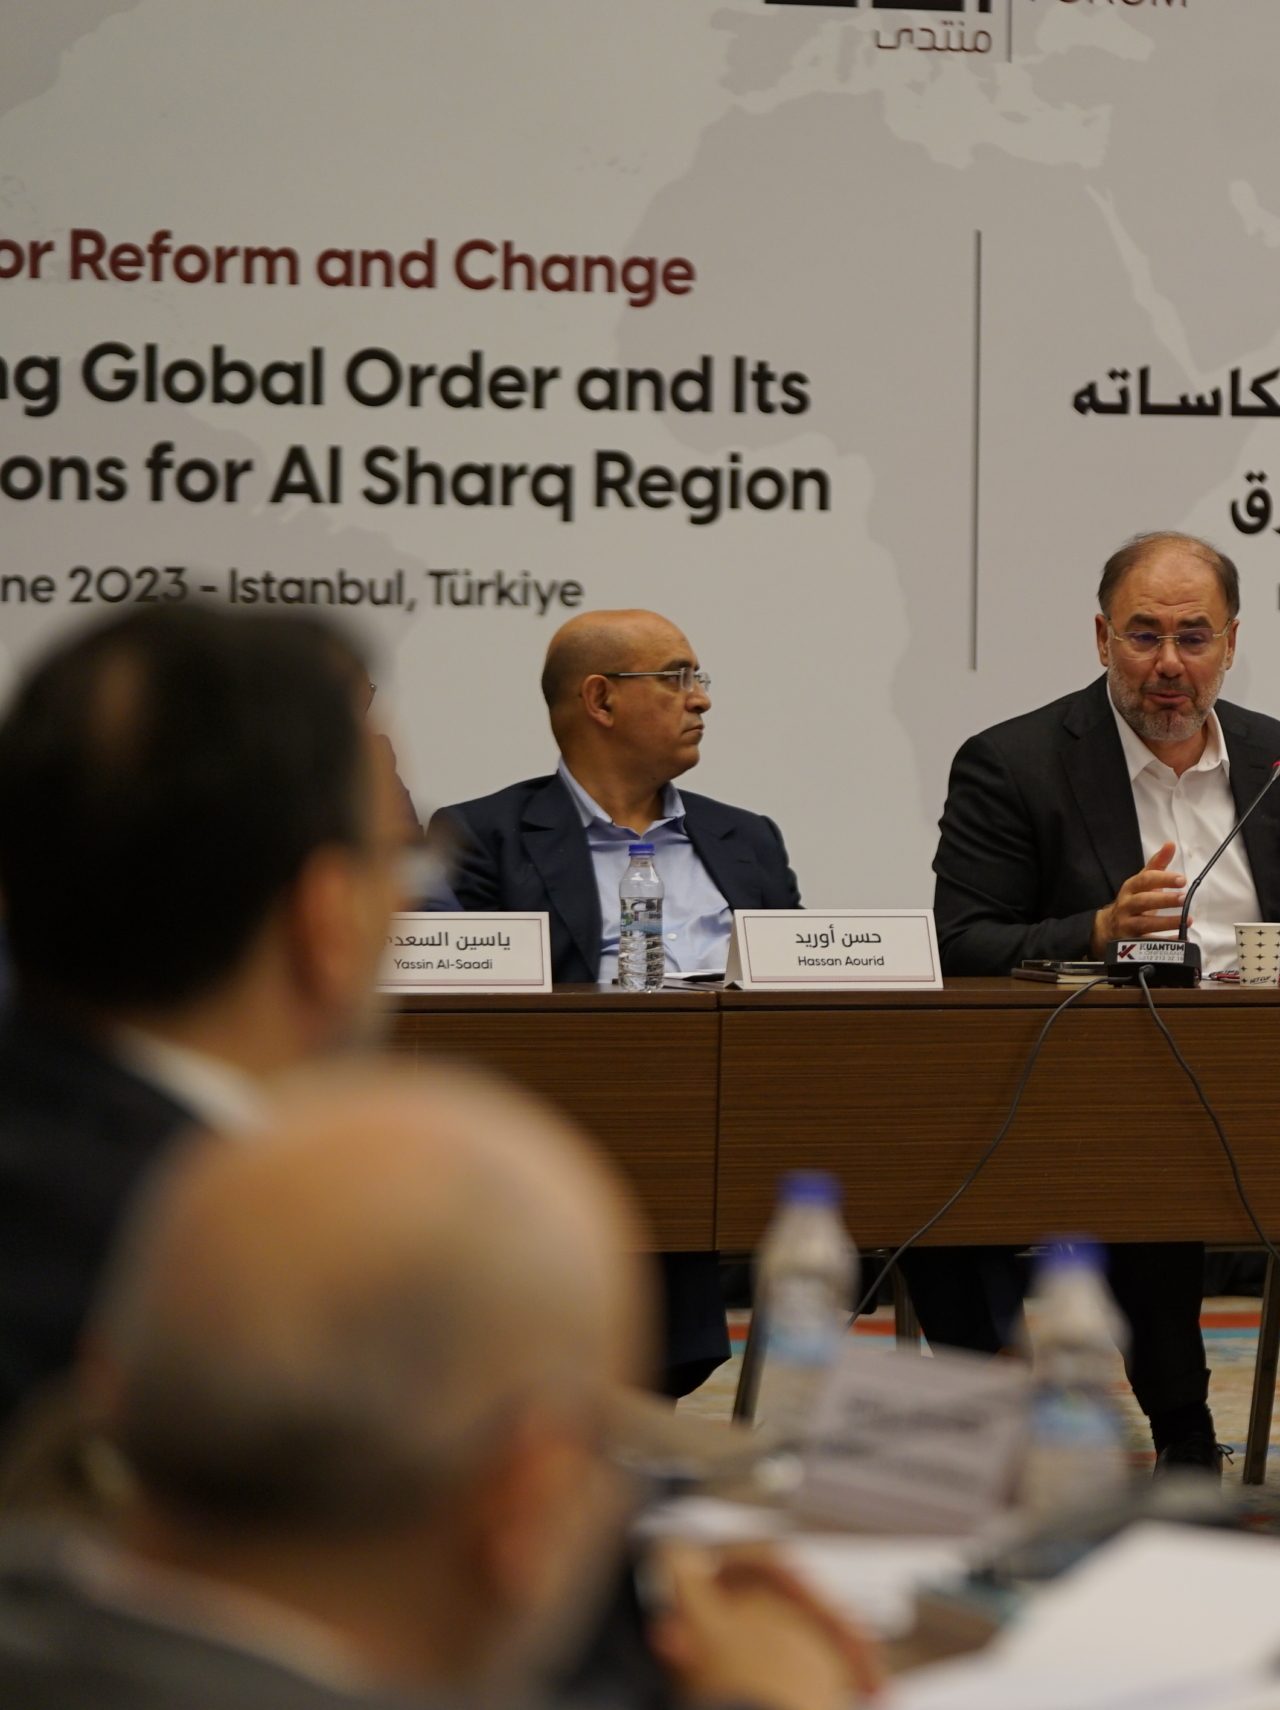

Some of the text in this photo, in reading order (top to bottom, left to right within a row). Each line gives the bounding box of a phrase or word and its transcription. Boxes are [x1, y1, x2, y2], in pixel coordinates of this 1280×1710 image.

[875, 21, 991, 53] منتدى
[70, 229, 299, 285] Reform
[316, 239, 436, 289] and
[454, 239, 695, 308] Change
[82, 342, 323, 405] Global
[345, 348, 560, 410] Order
[577, 355, 712, 413] and
[734, 356, 810, 415] Its
[145, 442, 253, 503] for
[270, 445, 341, 504] Al
[363, 446, 573, 522] Sharq
[595, 450, 829, 525] Region
[69, 566, 186, 604] 2023
[230, 568, 415, 612] Istanbul,
[427, 570, 583, 616] Türkiye
[456, 931, 511, 951] ياسين
[795, 923, 882, 949] حسن أوريد
[1140, 943, 1185, 952] KUANTUM
[393, 958, 493, 970] Yassin Al-Saadi
[797, 955, 885, 966] Hassan Aourid
